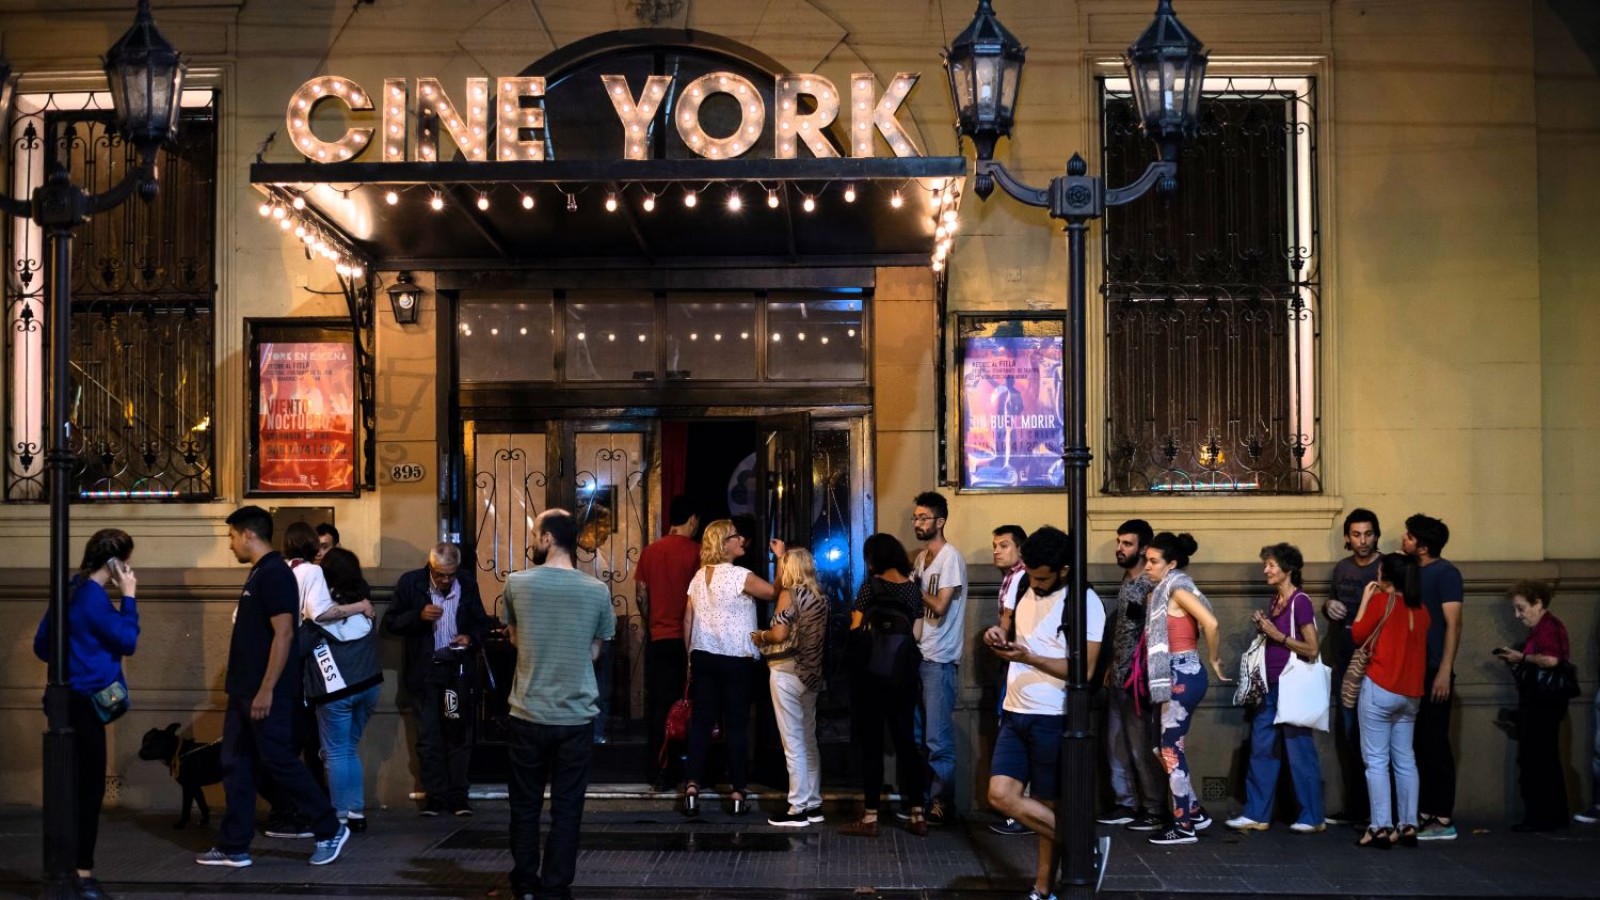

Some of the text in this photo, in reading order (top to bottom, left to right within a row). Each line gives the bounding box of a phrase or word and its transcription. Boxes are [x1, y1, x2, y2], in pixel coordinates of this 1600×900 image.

[286, 71, 926, 163] CINE YORK
[294, 351, 308, 361] EN
[267, 398, 309, 415] VIENTO
[991, 414, 1017, 428] BUEN
[1021, 414, 1056, 428] MORIR
[392, 464, 422, 480] 895
